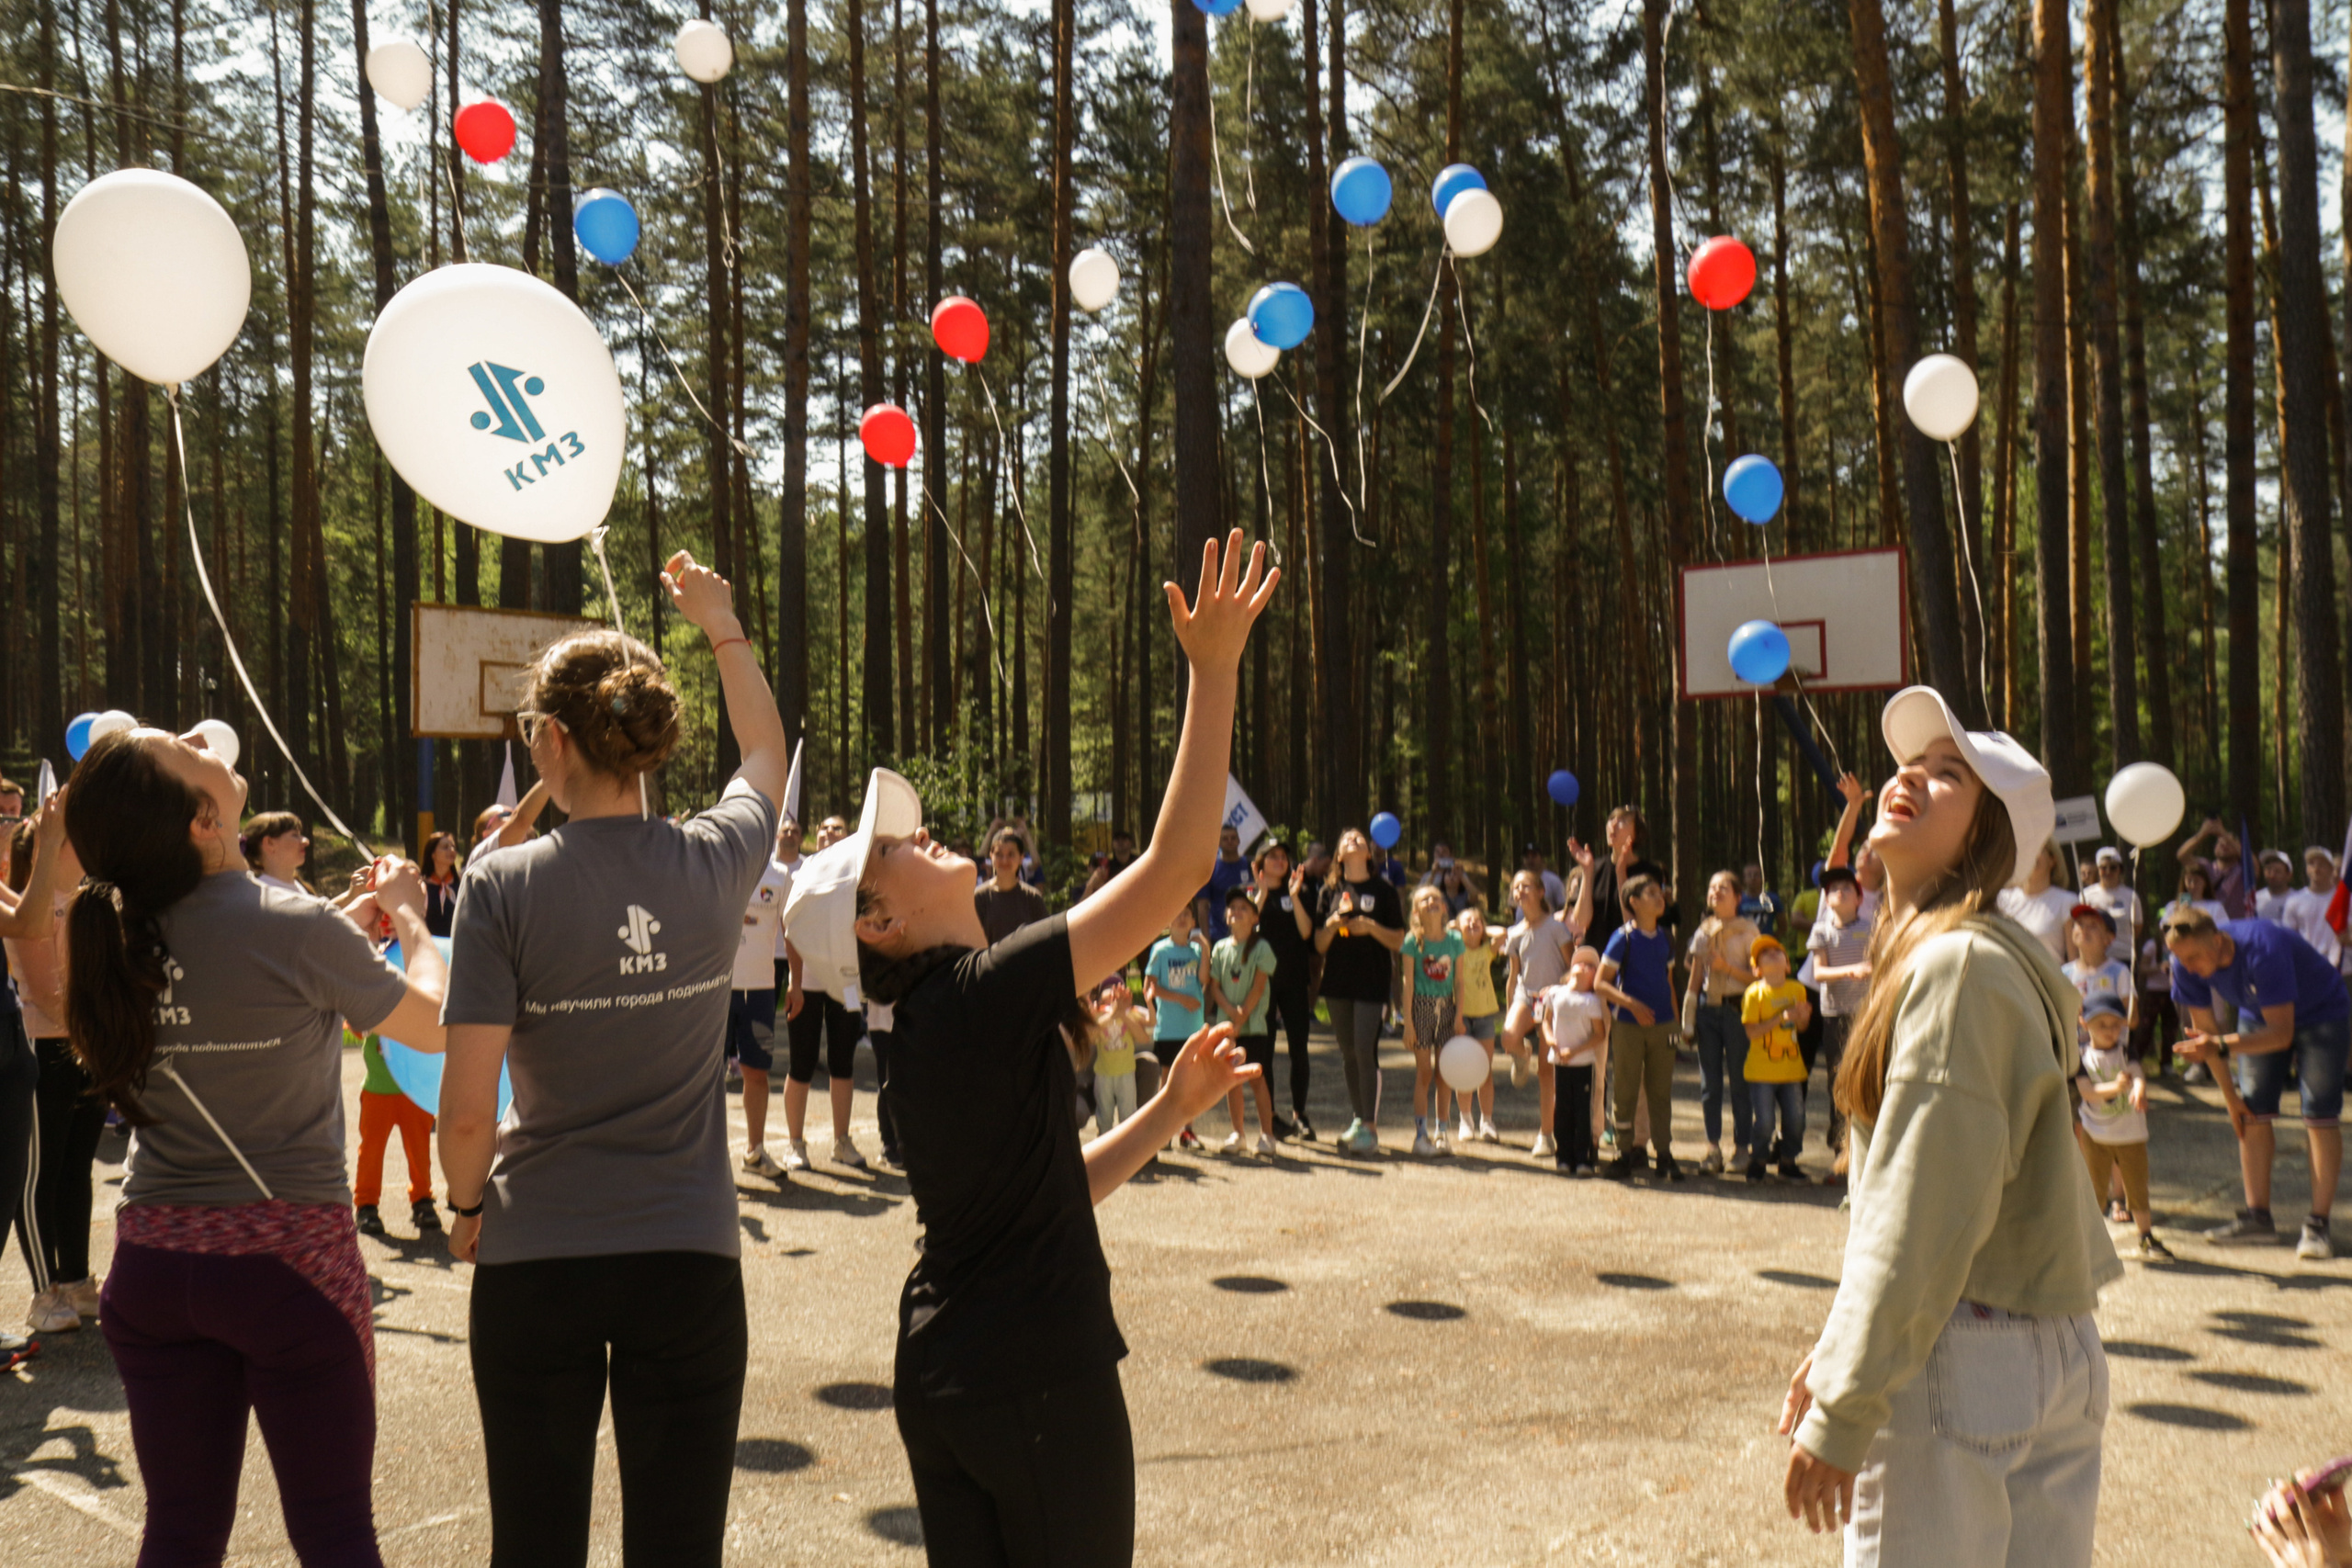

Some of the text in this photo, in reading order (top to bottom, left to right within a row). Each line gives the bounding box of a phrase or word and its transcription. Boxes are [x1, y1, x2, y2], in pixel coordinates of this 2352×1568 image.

[503, 431, 585, 491] КМЗ
[619, 952, 668, 976] КМЗ
[525, 999, 548, 1015] Мы
[550, 996, 612, 1014] научили
[616, 990, 663, 1010] города
[151, 1006, 192, 1025] МЗ
[153, 1036, 282, 1056] орода подниматься
